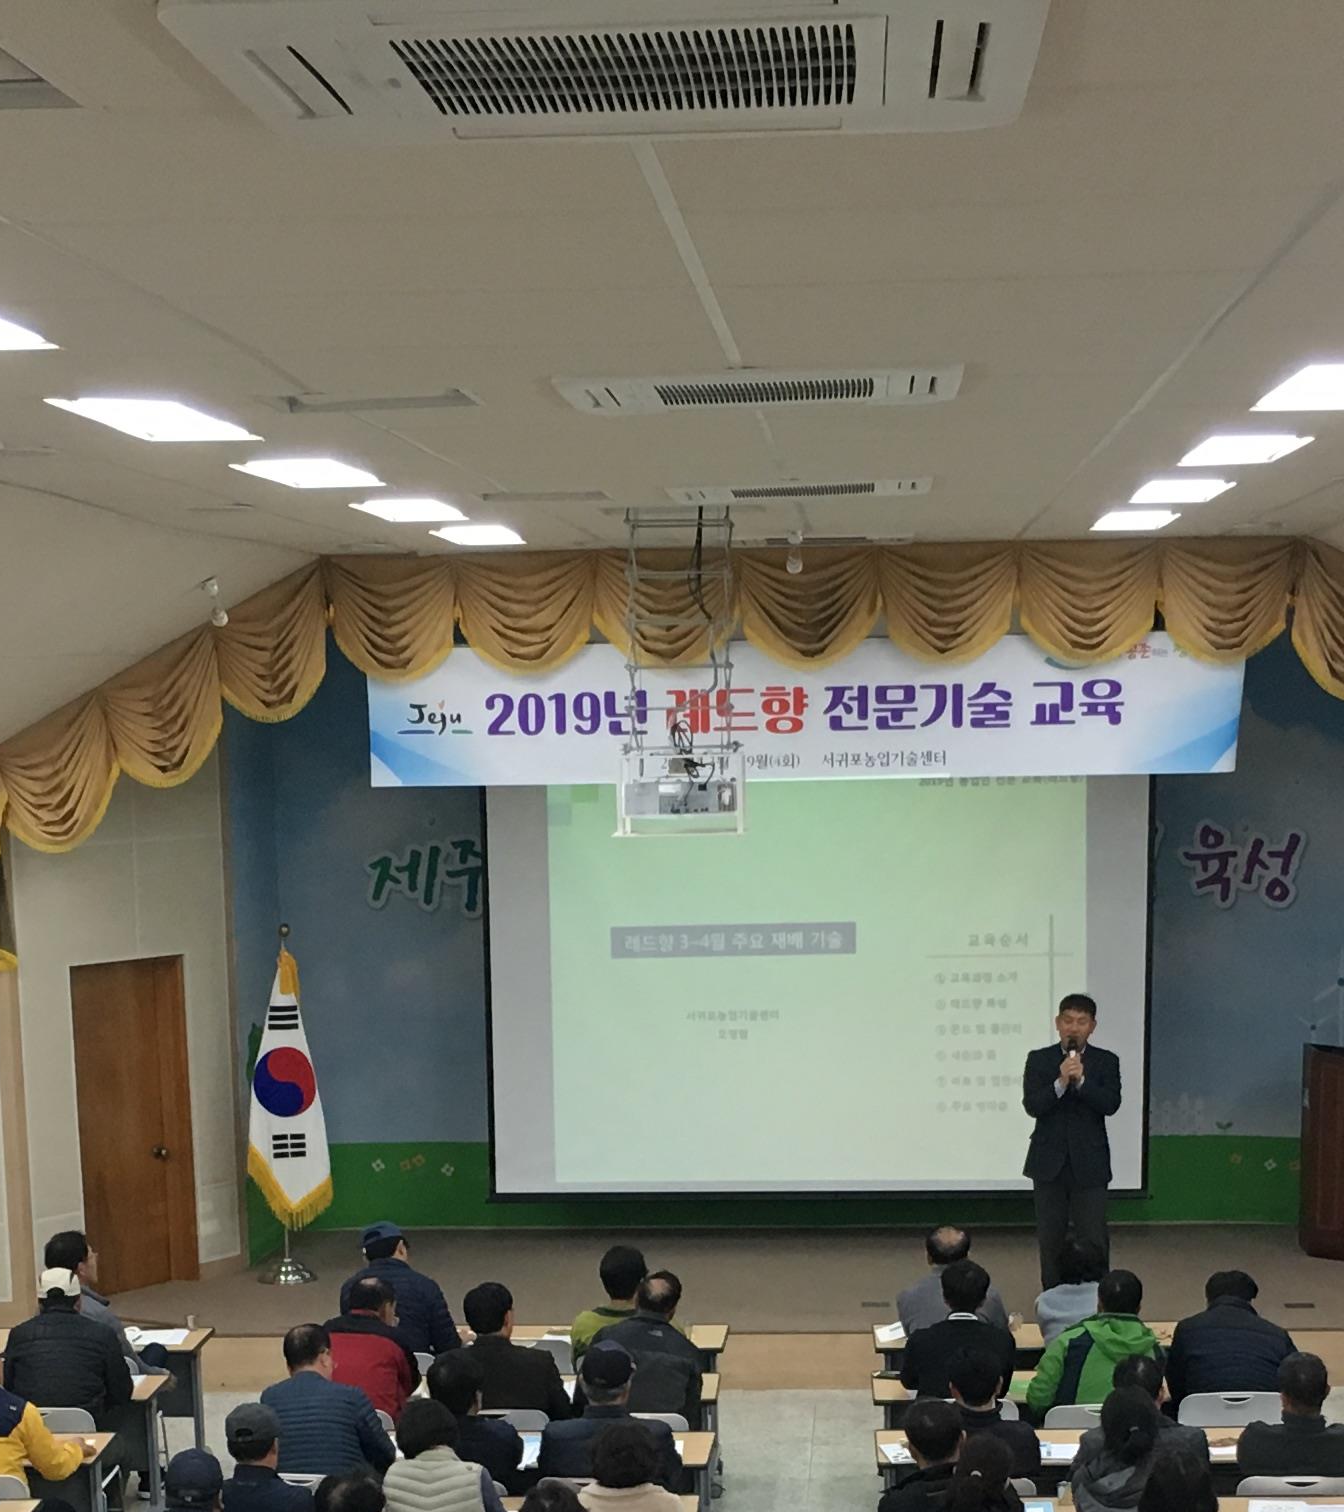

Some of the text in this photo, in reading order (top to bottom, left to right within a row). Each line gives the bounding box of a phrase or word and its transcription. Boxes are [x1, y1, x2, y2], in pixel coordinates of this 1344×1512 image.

[406, 702, 462, 736] Jeju
[485, 678, 1125, 737] 2019년 레드향 전문기술 교육
[822, 750, 947, 768] 서귀포농업기술센터
[368, 839, 483, 912] 제주
[1182, 824, 1302, 903] 육성
